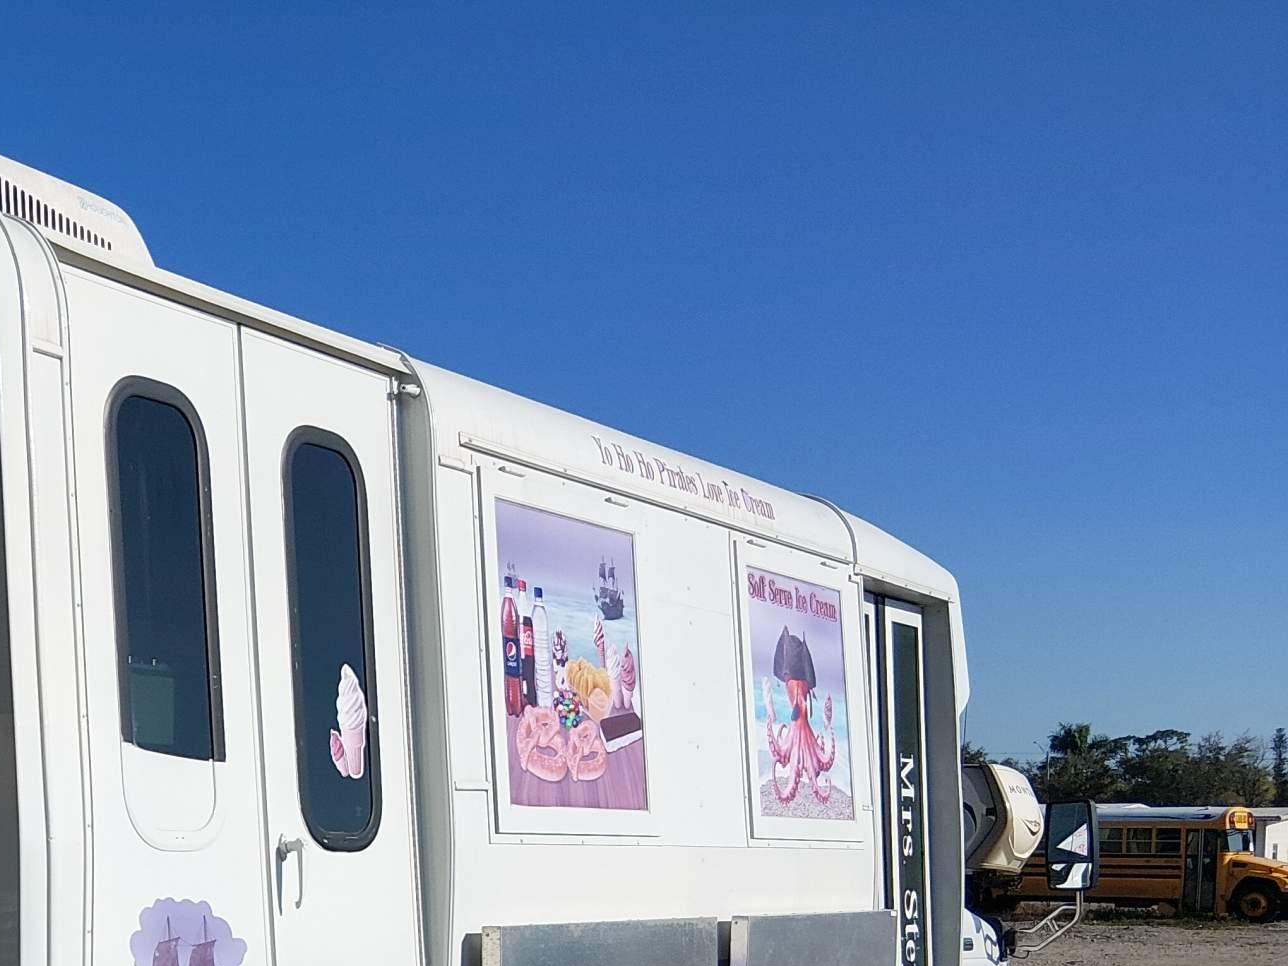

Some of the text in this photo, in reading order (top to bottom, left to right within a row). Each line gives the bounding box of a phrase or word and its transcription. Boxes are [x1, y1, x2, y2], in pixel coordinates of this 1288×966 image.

[592, 436, 775, 520] Yo Ho Ho Pirates Love Ice Cream
[747, 573, 838, 623] Soft Serve Ice Cream
